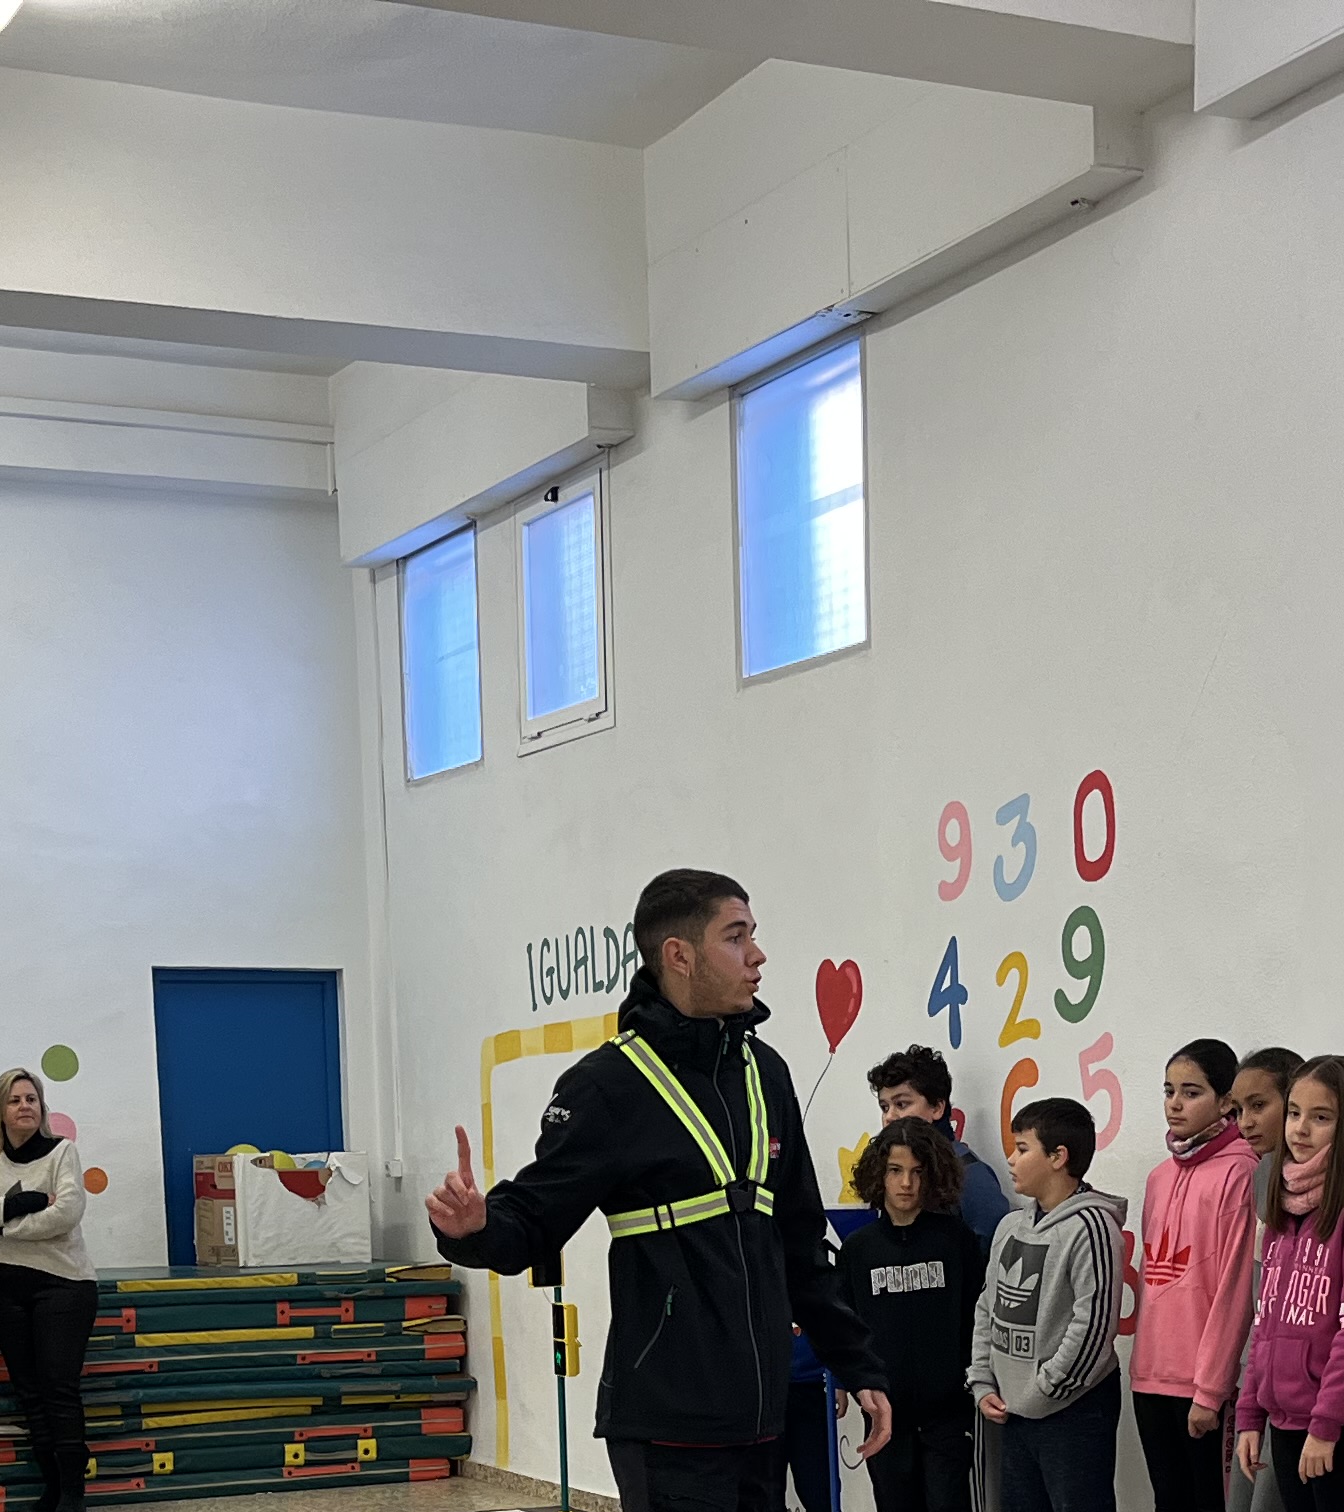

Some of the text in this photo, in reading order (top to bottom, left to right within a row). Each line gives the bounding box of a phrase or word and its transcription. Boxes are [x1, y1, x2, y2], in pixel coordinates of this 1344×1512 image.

[938, 769, 1115, 902] 9 3 0
[527, 921, 639, 1012] IGUALDA
[927, 905, 1105, 1050] 4 2 9
[1078, 1031, 1123, 1151] 5
[870, 1260, 946, 1296] PUMA
[1015, 1335, 1031, 1353] 03
